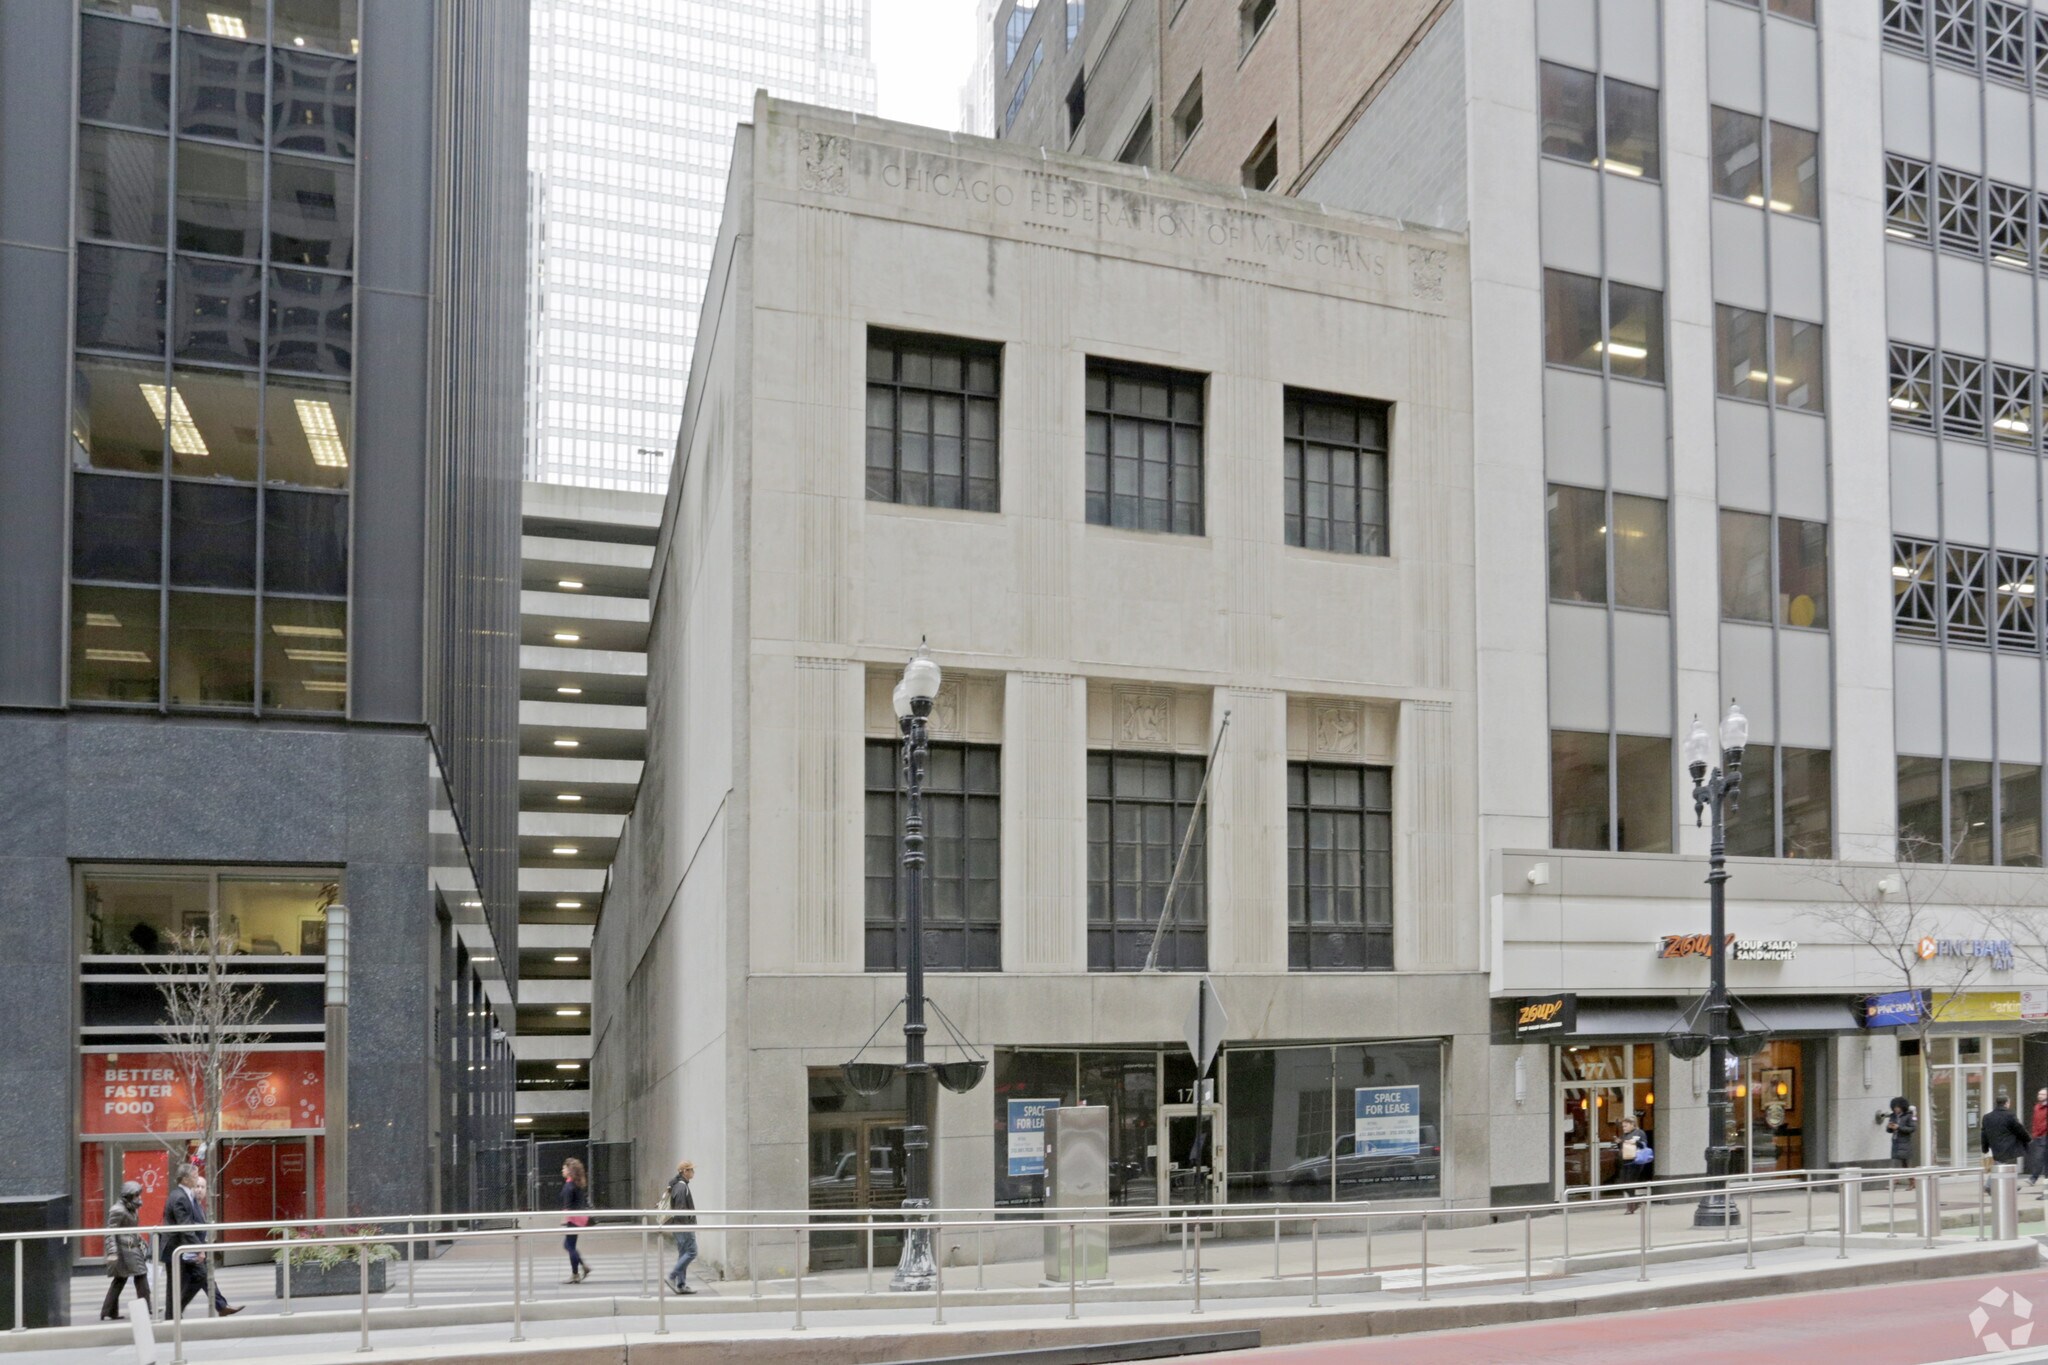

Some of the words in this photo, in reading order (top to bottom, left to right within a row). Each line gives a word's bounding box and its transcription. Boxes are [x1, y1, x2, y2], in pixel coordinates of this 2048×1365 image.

[881, 164, 1014, 207] CHICAGO
[1030, 190, 1196, 239] FEDERATION
[1207, 223, 1240, 249] OF
[1990, 1000, 2021, 1013] Parkin
[105, 1068, 179, 1082] BETTER,
[105, 1085, 172, 1098] FASTER
[1177, 1088, 1194, 1103] 17
[1374, 1092, 1401, 1103] SPACE
[105, 1101, 154, 1115] FOOD
[1365, 1105, 1383, 1115] FOR
[1385, 1103, 1410, 1114] LEASE
[1016, 1118, 1031, 1129] FOR
[1032, 1118, 1044, 1129] LEA
